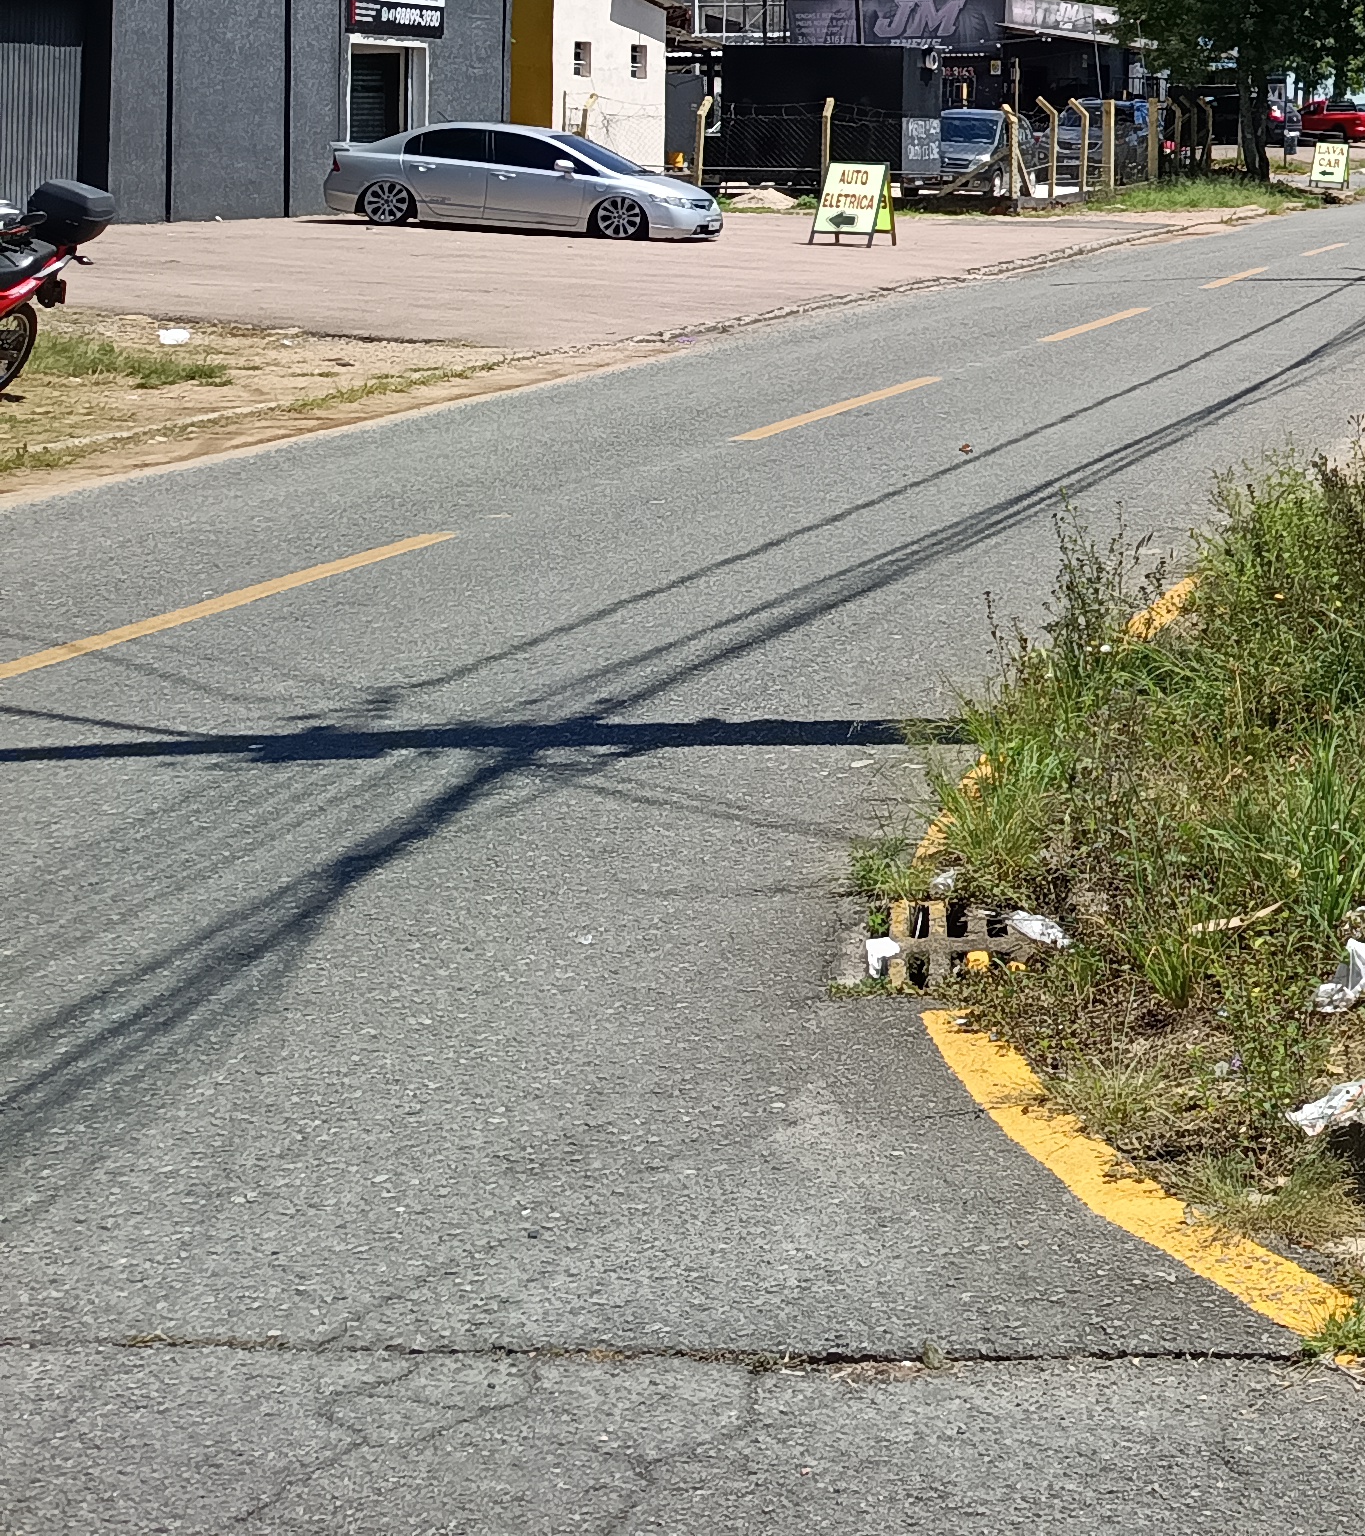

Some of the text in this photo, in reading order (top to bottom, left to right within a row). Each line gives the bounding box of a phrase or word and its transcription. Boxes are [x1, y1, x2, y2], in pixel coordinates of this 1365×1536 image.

[1317, 145, 1345, 156] LAVA
[1318, 158, 1341, 169] CAR
[839, 169, 869, 186] AUTO
[822, 189, 875, 210] ELÉTRICA
